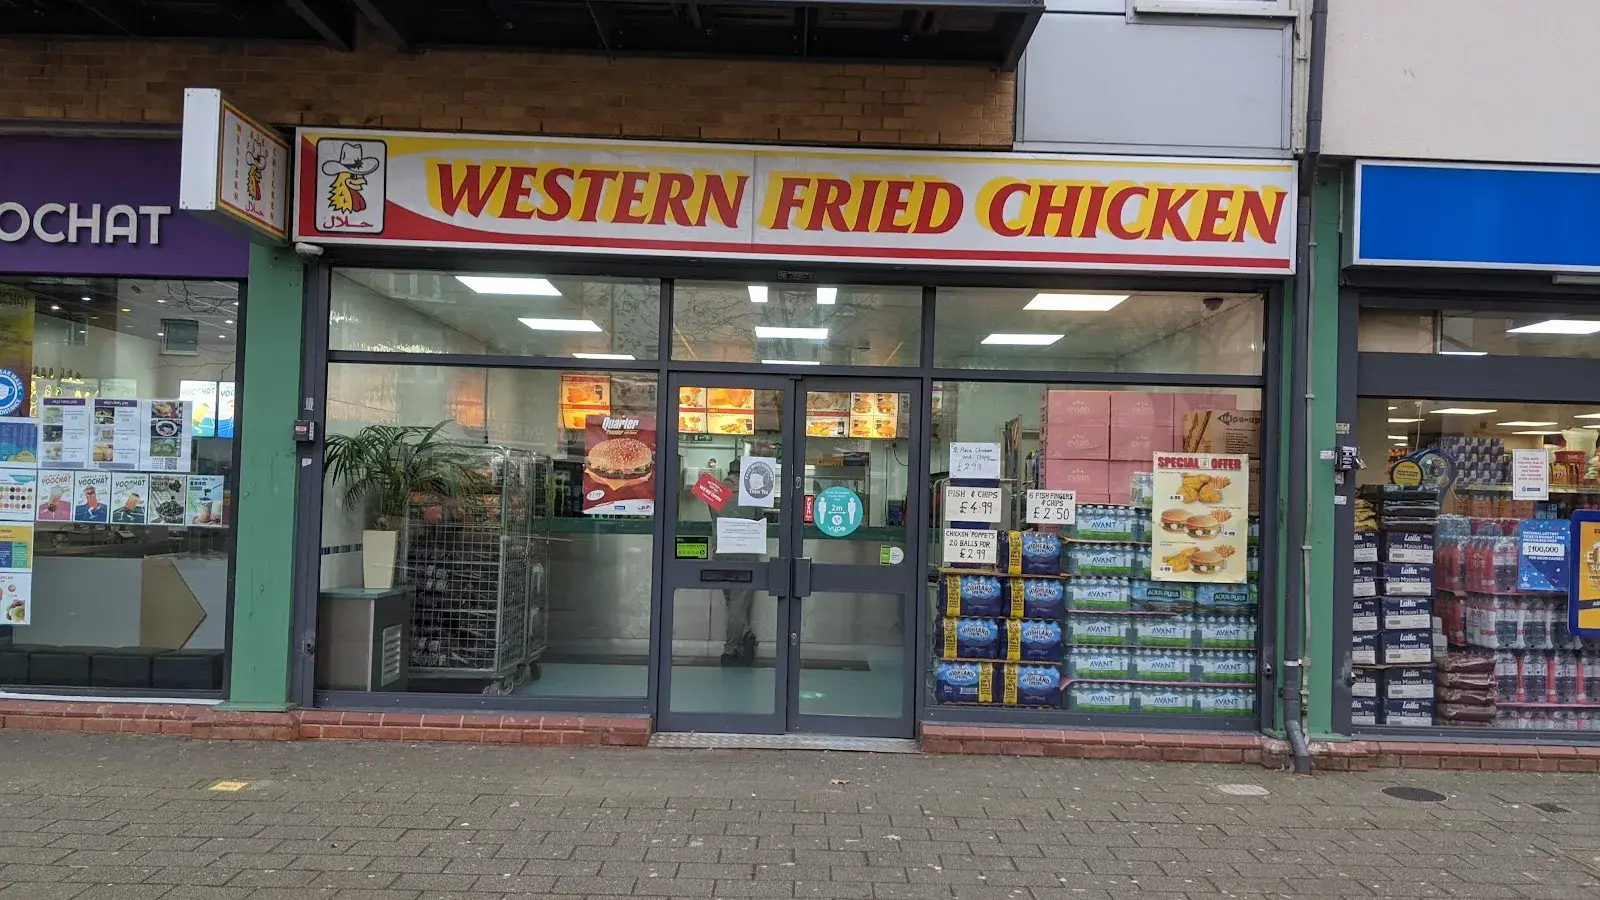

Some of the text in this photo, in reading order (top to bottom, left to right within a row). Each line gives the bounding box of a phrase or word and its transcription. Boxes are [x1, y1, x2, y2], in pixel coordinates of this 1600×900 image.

[269, 148, 277, 220] CHICKEN
[434, 162, 1288, 244] WESTERN FRIED CHICKEN
[322, 216, 374, 230] حلال
[1067, 404, 1089, 413] evian
[1131, 405, 1154, 414] evian
[602, 416, 639, 431] Quarter
[1067, 438, 1089, 447] evian
[1131, 439, 1152, 448] evian
[1157, 456, 1242, 471] SPECIAL OFFER
[41, 475, 71, 485] YOOCHAT
[78, 476, 108, 486] YOOCHAT
[1067, 473, 1089, 482] evian
[977, 491, 998, 499] CHIPS
[831, 504, 843, 512] 2m
[1091, 521, 1117, 529] AVANT
[1092, 556, 1118, 564] AVANT
[965, 584, 993, 594] HIGHLAND
[1028, 586, 1056, 597] HIGHLAND
[1148, 588, 1180, 598] AQUA PURA
[1230, 594, 1247, 602] PURA
[961, 627, 989, 636] HIGHLAND
[1024, 629, 1052, 638] HIGHLAND
[1152, 627, 1177, 635] AVANT
[1216, 629, 1240, 637] AVANT
[1151, 661, 1176, 669] AVANT
[1217, 663, 1242, 671] AVANT
[1022, 675, 1050, 684] HIGHLAND
[1090, 695, 1115, 703] AVANT
[1214, 698, 1239, 706] AVANT
